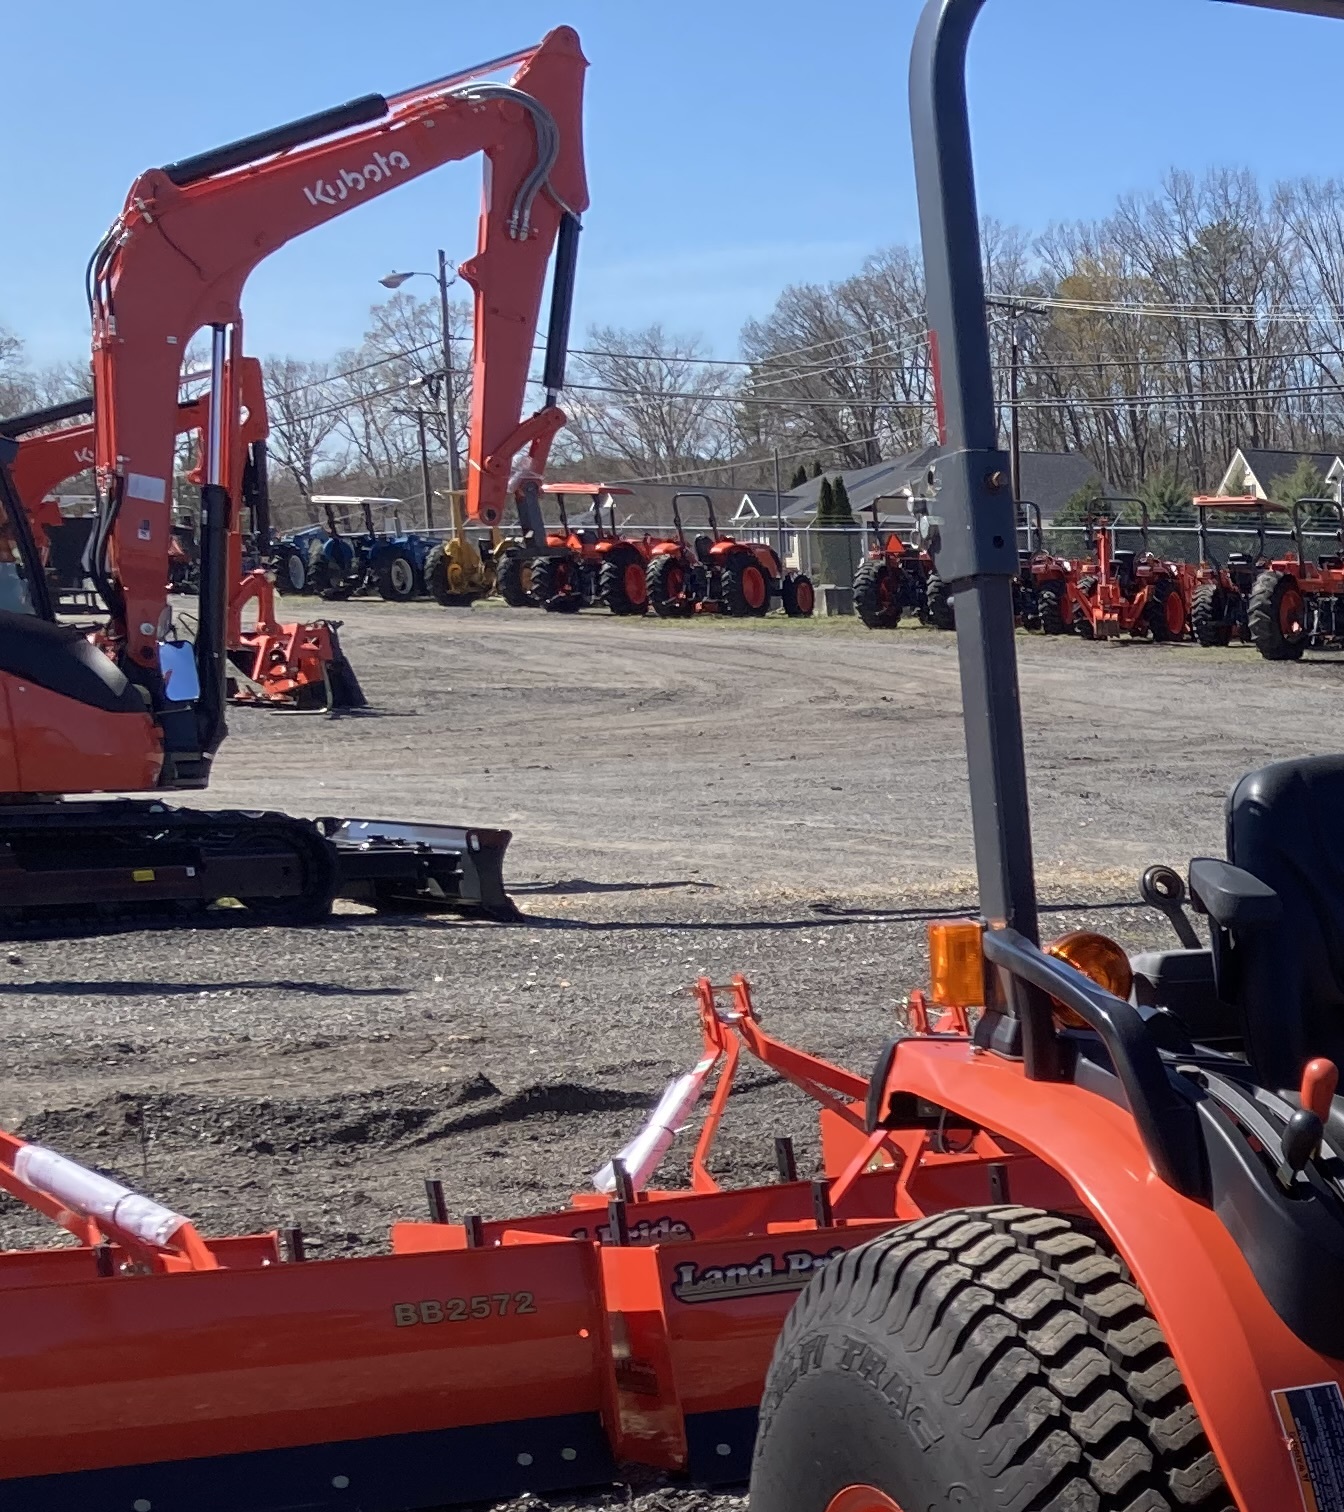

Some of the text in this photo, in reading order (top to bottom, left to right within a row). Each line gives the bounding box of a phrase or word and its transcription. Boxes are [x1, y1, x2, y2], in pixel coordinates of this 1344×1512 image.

[303, 150, 411, 206] Kubota
[677, 1256, 773, 1293] Land
[393, 1291, 538, 1328] BB2572
[838, 1334, 946, 1452] TRAC
